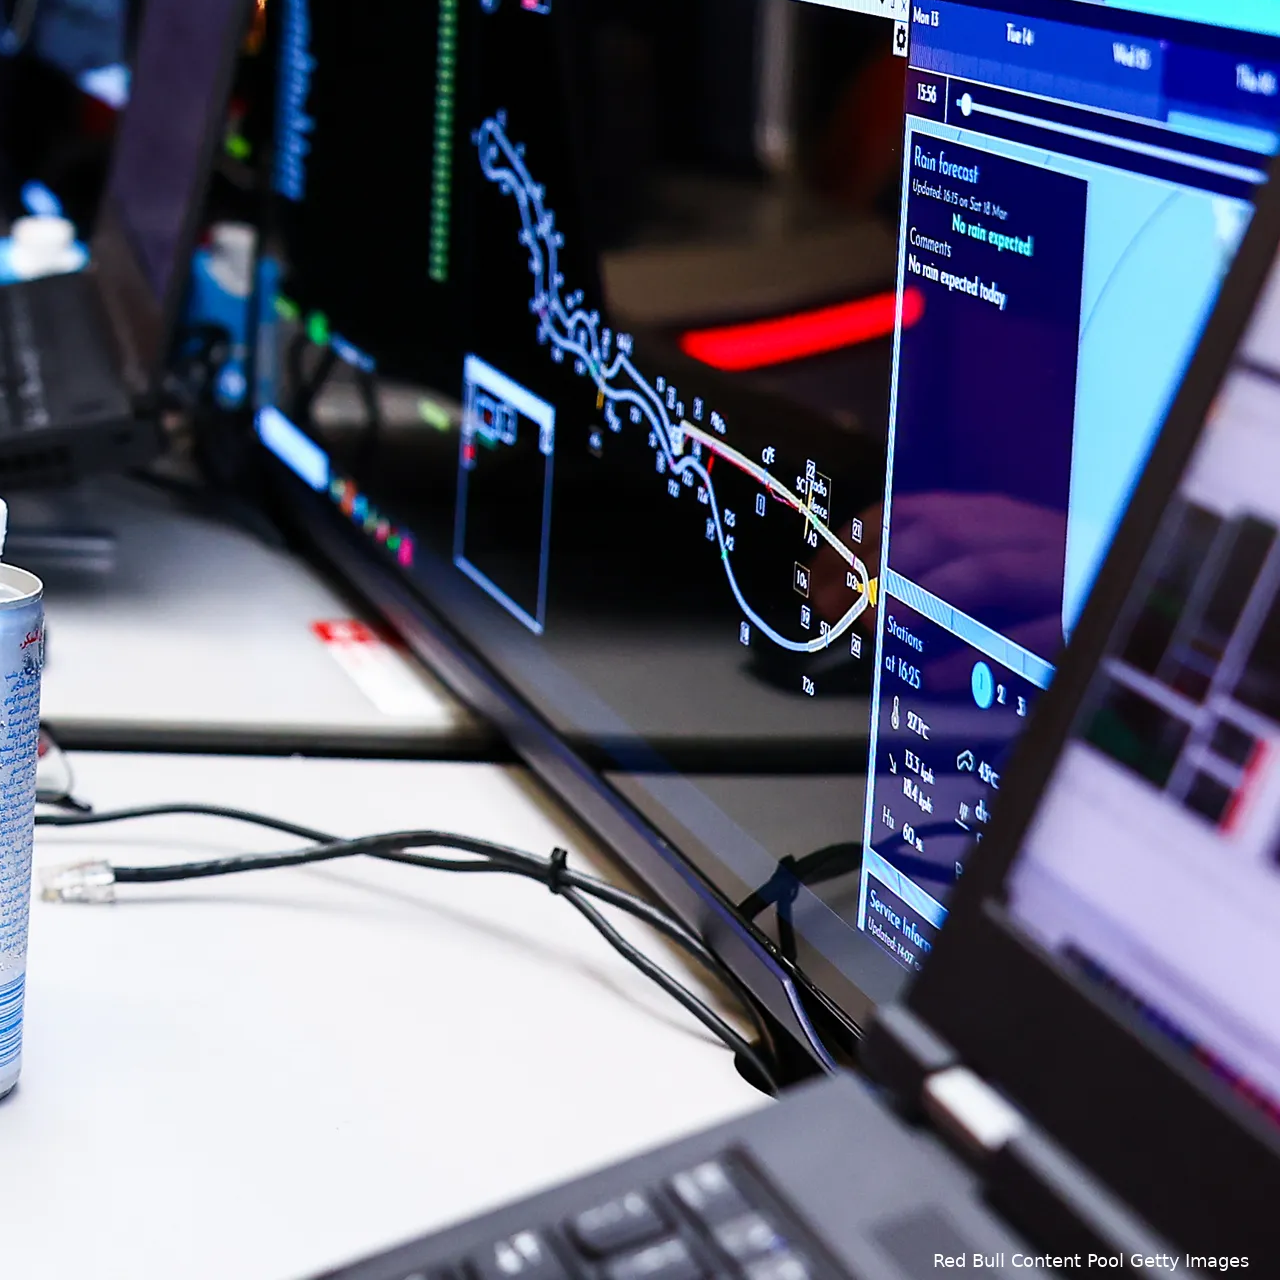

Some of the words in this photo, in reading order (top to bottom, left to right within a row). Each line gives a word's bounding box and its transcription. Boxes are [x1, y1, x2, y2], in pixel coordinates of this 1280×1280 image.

[913, 6, 930, 25] Mon
[914, 145, 936, 171] Rain
[939, 151, 979, 183] forecast
[970, 196, 982, 213] Sat
[909, 227, 952, 258] Comments
[952, 213, 966, 234] No
[968, 223, 986, 241] rain
[988, 230, 1034, 257] expected
[908, 253, 921, 274] No
[922, 263, 938, 281] rain
[940, 270, 979, 296] expected
[979, 281, 1007, 310] today
[887, 615, 924, 652] Stations
[885, 655, 896, 673] at
[882, 805, 895, 830] Hu
[902, 822, 915, 846] 60
[869, 889, 901, 930] Service
